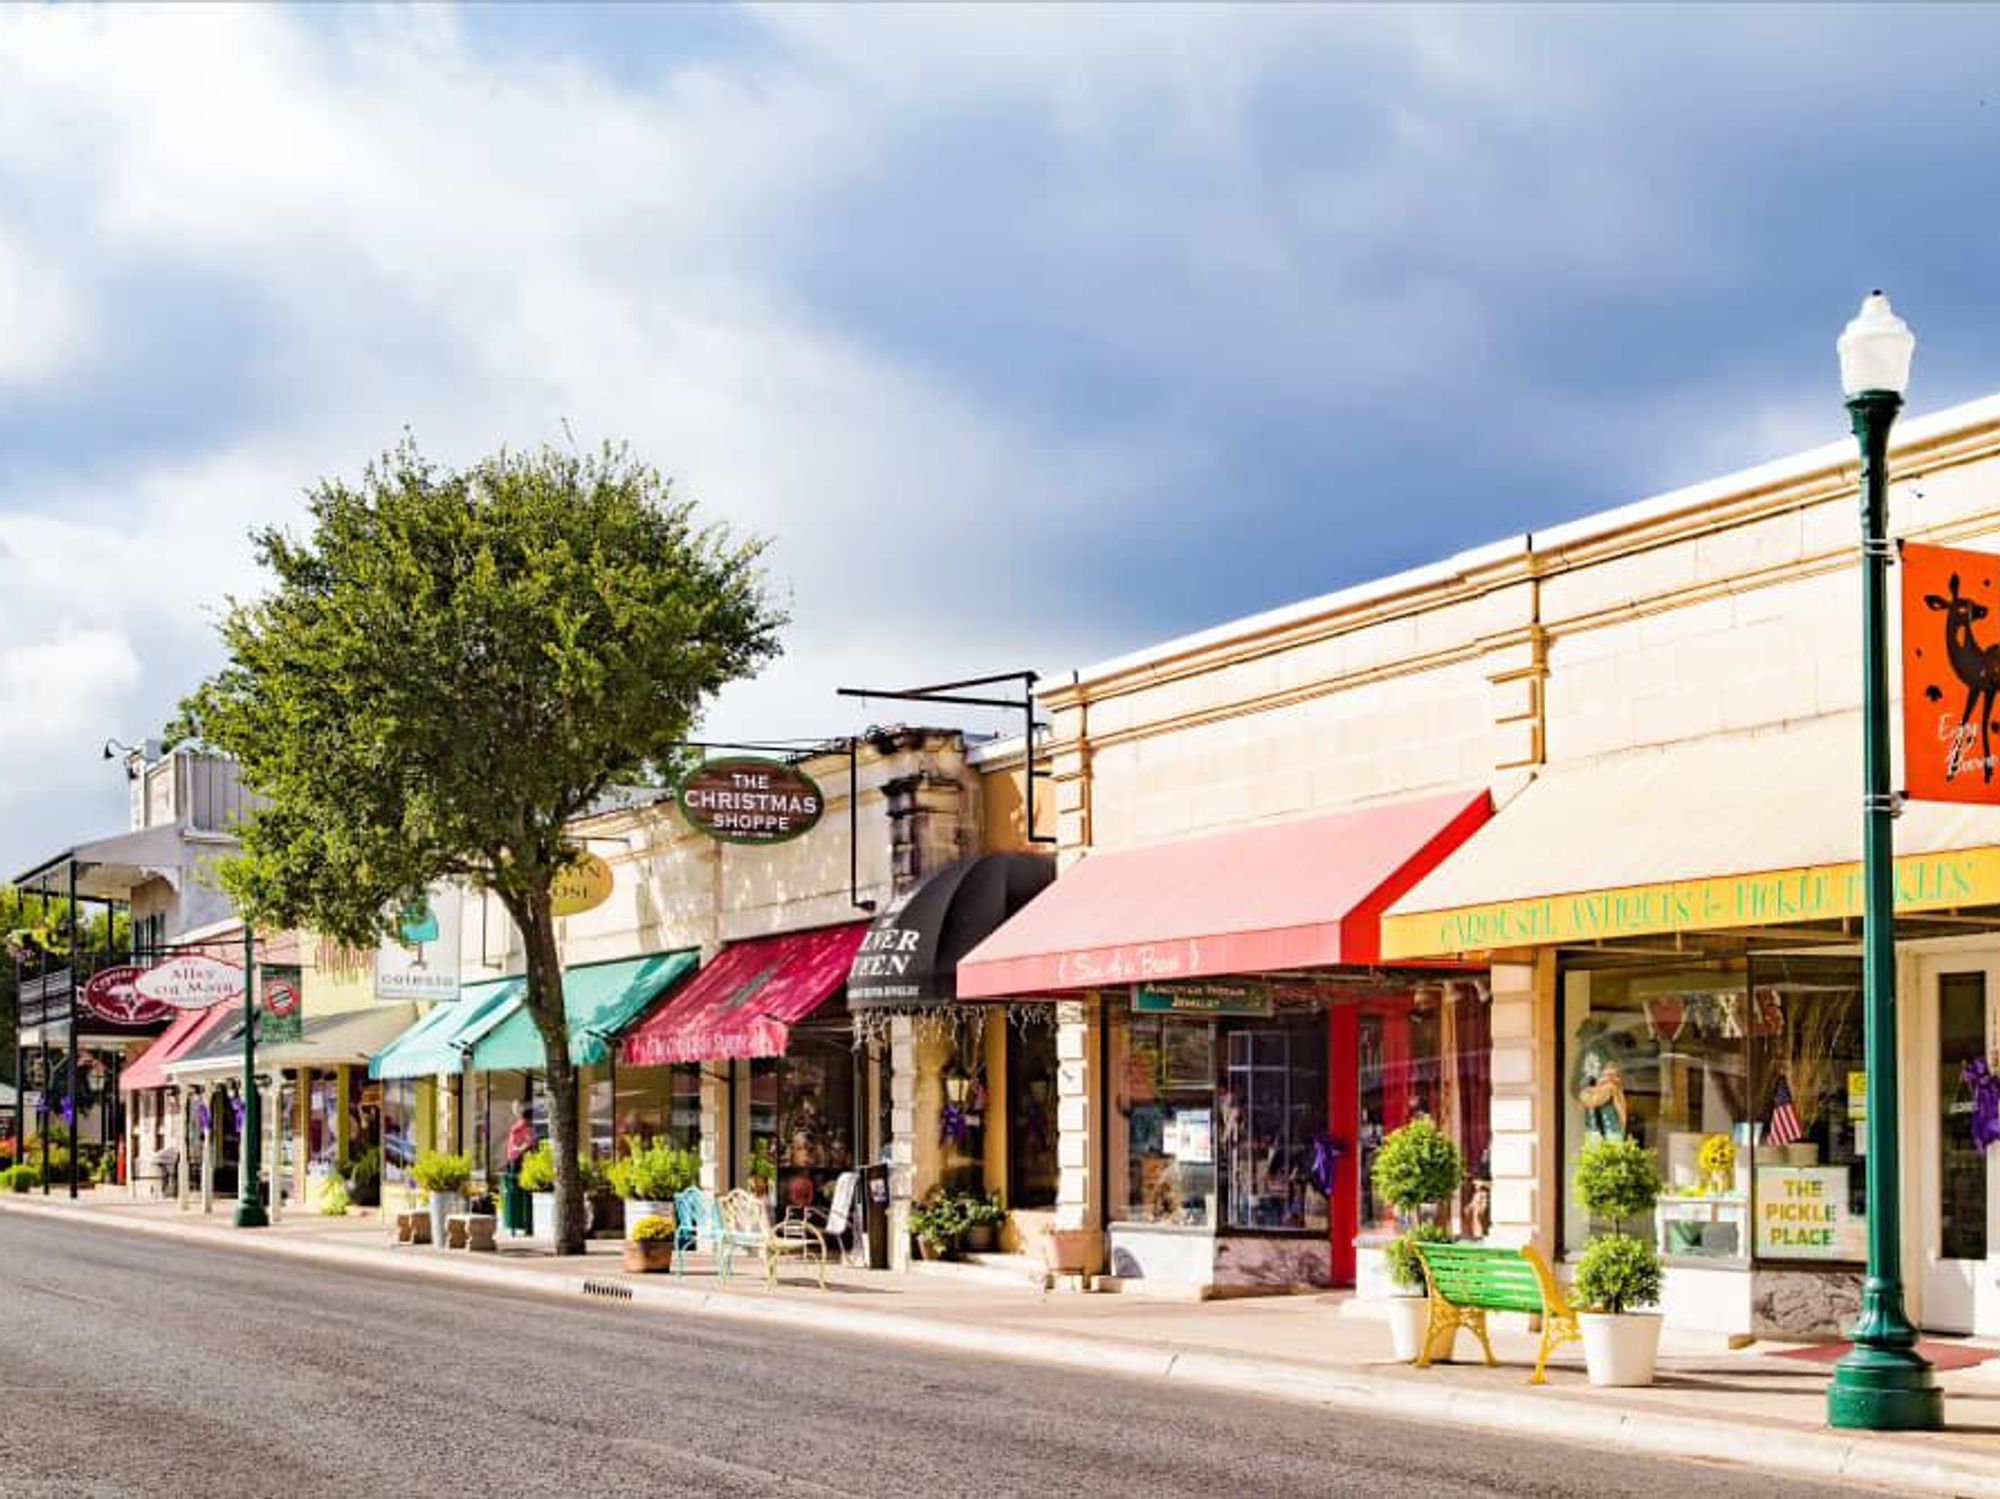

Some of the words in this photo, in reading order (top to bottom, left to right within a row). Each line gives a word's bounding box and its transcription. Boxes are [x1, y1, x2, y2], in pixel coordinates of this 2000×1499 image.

[731, 774, 770, 789] THE
[684, 790, 817, 814] CHRISTMAS
[713, 813, 791, 830] SHOPPE
[1441, 898, 1554, 946] CAROUSEL
[1568, 889, 1693, 935] ANTIQUES
[1734, 873, 1830, 918] PICKLE
[1783, 1180, 1823, 1198] THE
[1766, 1203, 1837, 1223] PICKLE
[1770, 1228, 1835, 1246] PLACE
